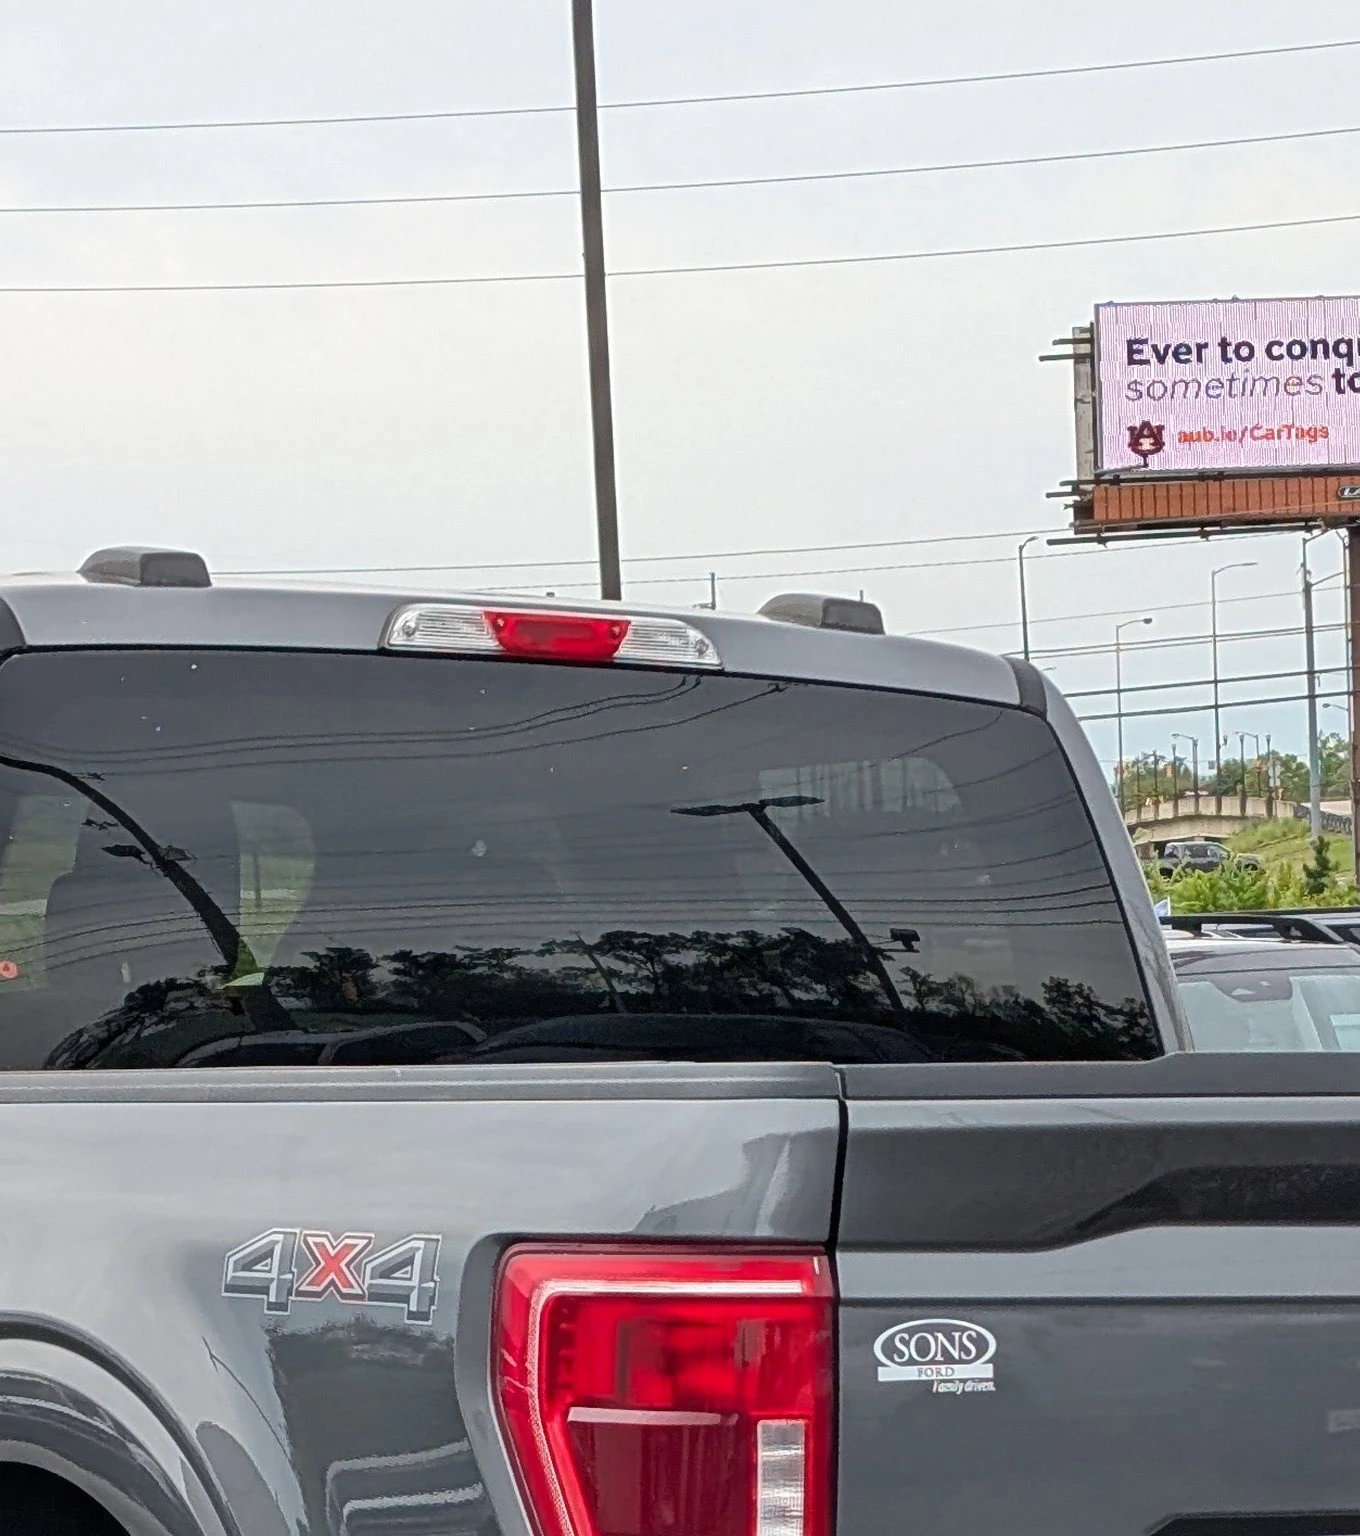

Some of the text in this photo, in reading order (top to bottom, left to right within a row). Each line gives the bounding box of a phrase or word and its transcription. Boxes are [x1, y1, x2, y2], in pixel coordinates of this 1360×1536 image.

[1126, 337, 1208, 366] Ever
[1218, 336, 1255, 363] to
[1125, 368, 1324, 402] sometimes
[893, 1330, 978, 1363] SONS
[917, 1367, 955, 1378] FORD
